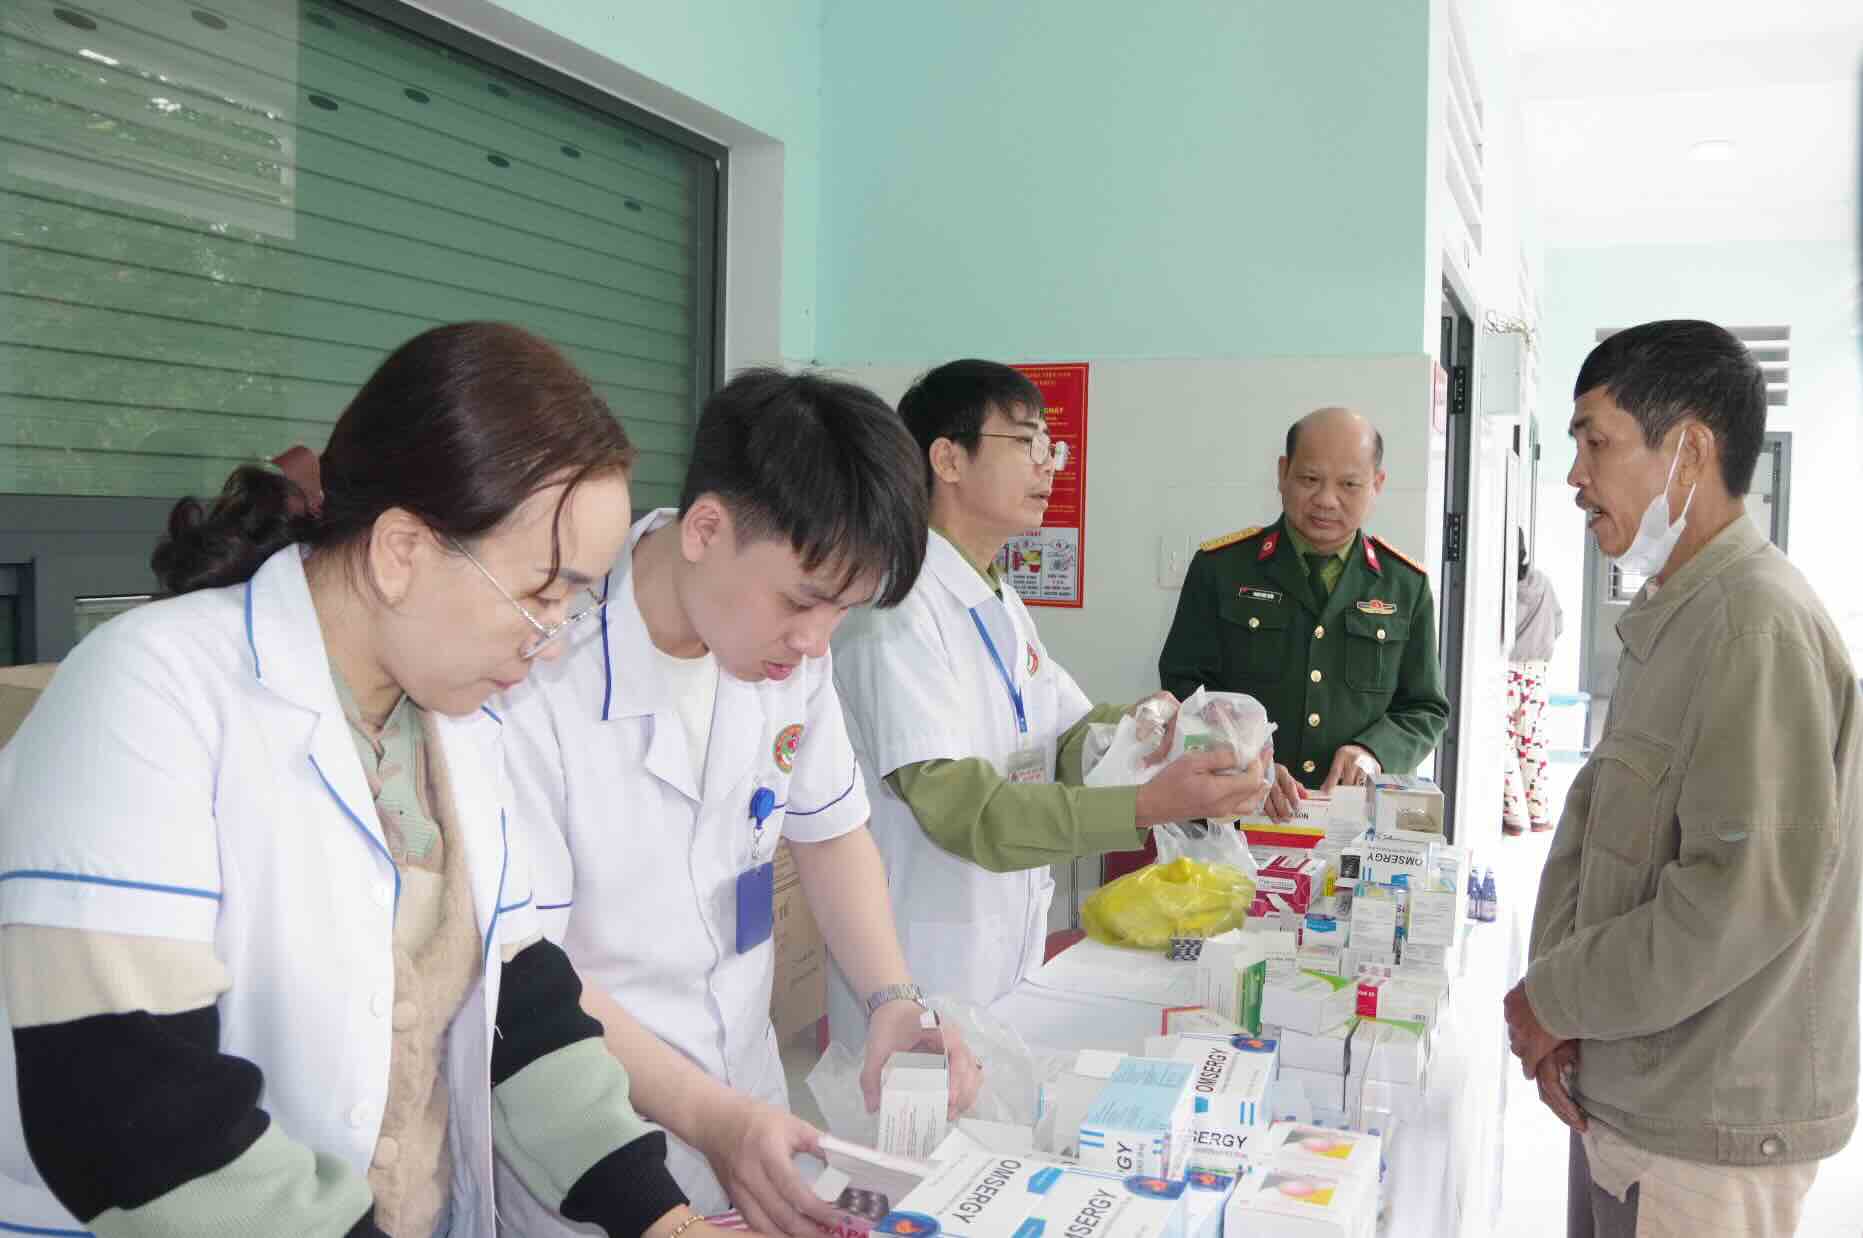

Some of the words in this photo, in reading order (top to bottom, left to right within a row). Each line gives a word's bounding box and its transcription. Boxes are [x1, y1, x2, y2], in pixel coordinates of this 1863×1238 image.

[1367, 851, 1424, 866] OMSERGY
[1195, 1047, 1228, 1093] OMSERGY
[952, 1159, 1022, 1224] OMSERGY
